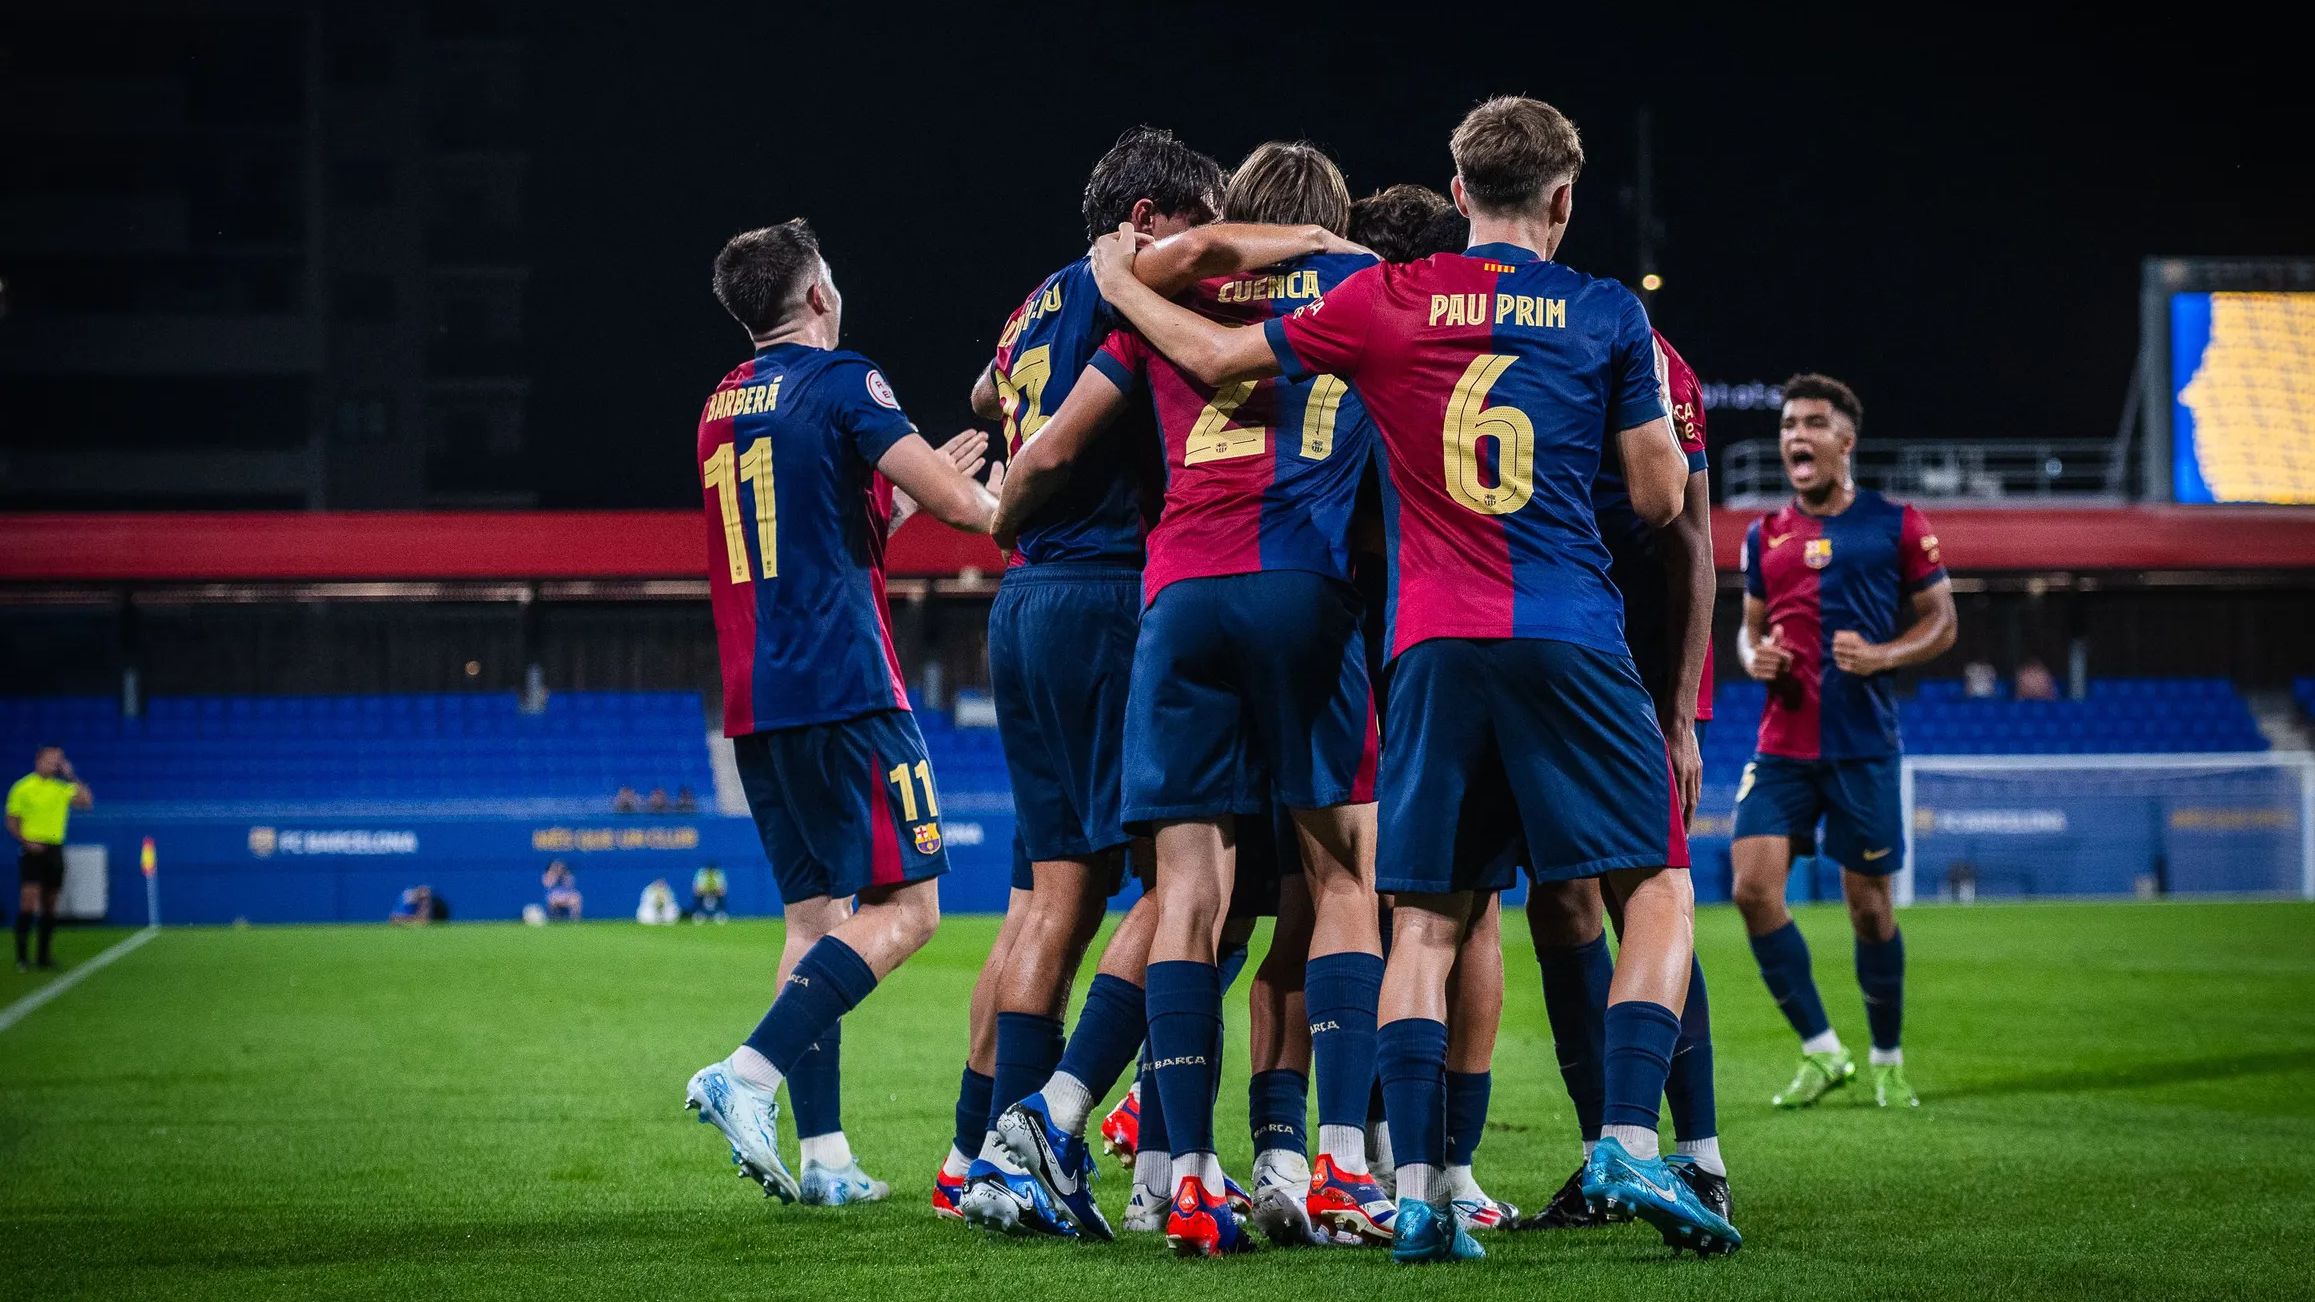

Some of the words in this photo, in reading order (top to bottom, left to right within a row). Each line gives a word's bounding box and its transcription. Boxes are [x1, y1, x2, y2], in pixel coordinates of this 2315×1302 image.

[1217, 271, 1320, 303] CUENCA
[1428, 293, 1488, 326] PAU
[1495, 293, 1566, 329] PRIM
[706, 375, 784, 423] BARBERÁ
[1443, 354, 1534, 514] 6
[703, 437, 779, 585] 11
[889, 759, 939, 822] 11
